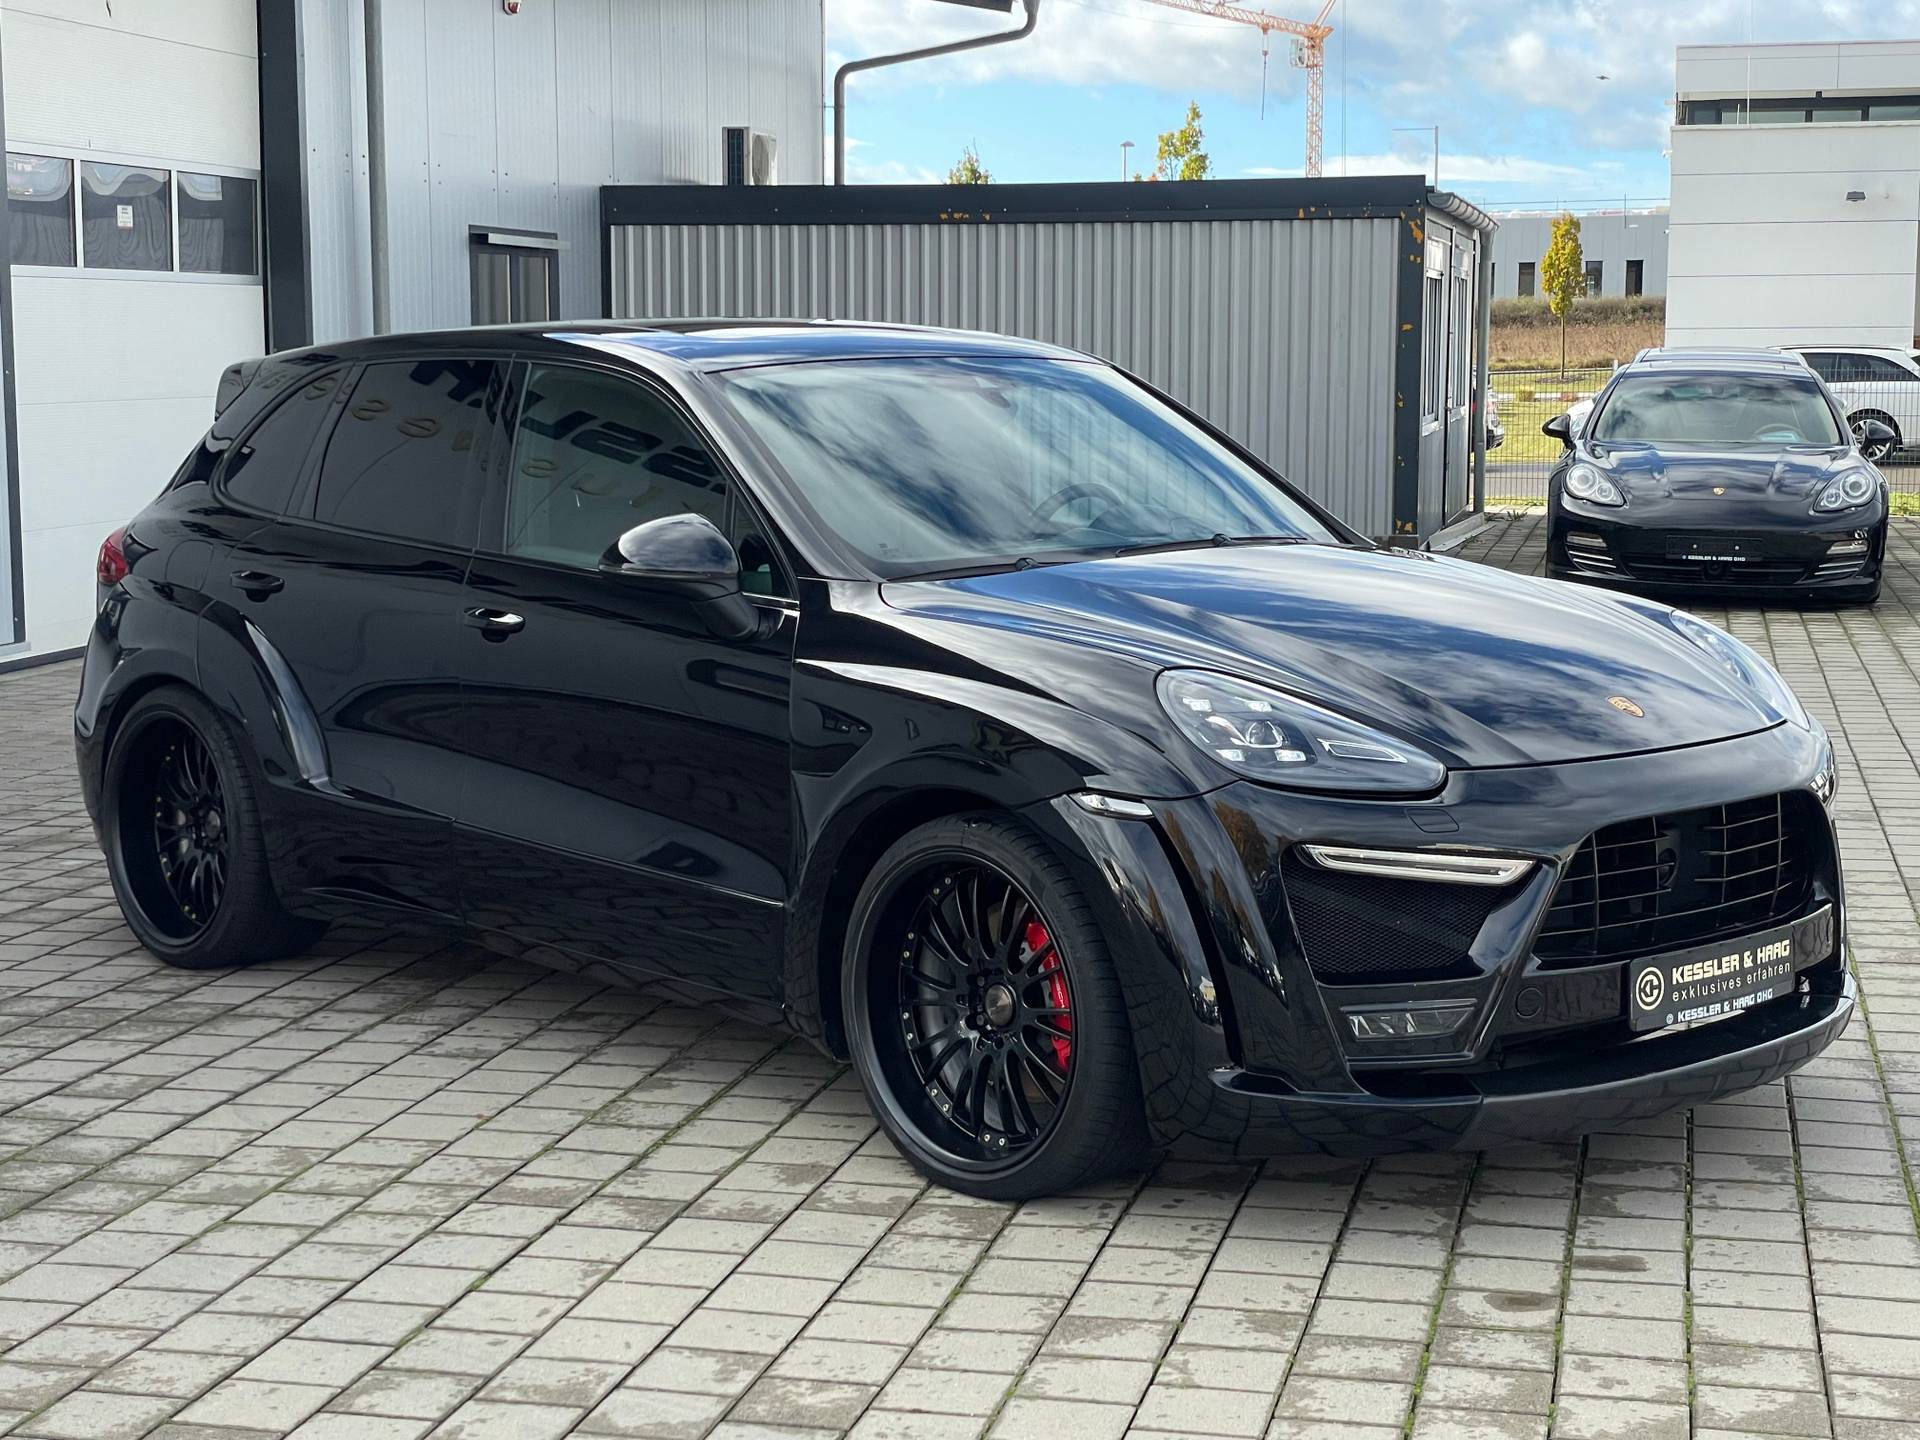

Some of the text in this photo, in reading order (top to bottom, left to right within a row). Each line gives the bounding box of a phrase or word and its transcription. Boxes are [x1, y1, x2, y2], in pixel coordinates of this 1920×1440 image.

[1672, 939, 1790, 985] KESSLER & HAAG
[1672, 962, 1790, 1002] exklusives erfahren
[1677, 988, 1773, 1023] KESSLER & HAAG OHG
